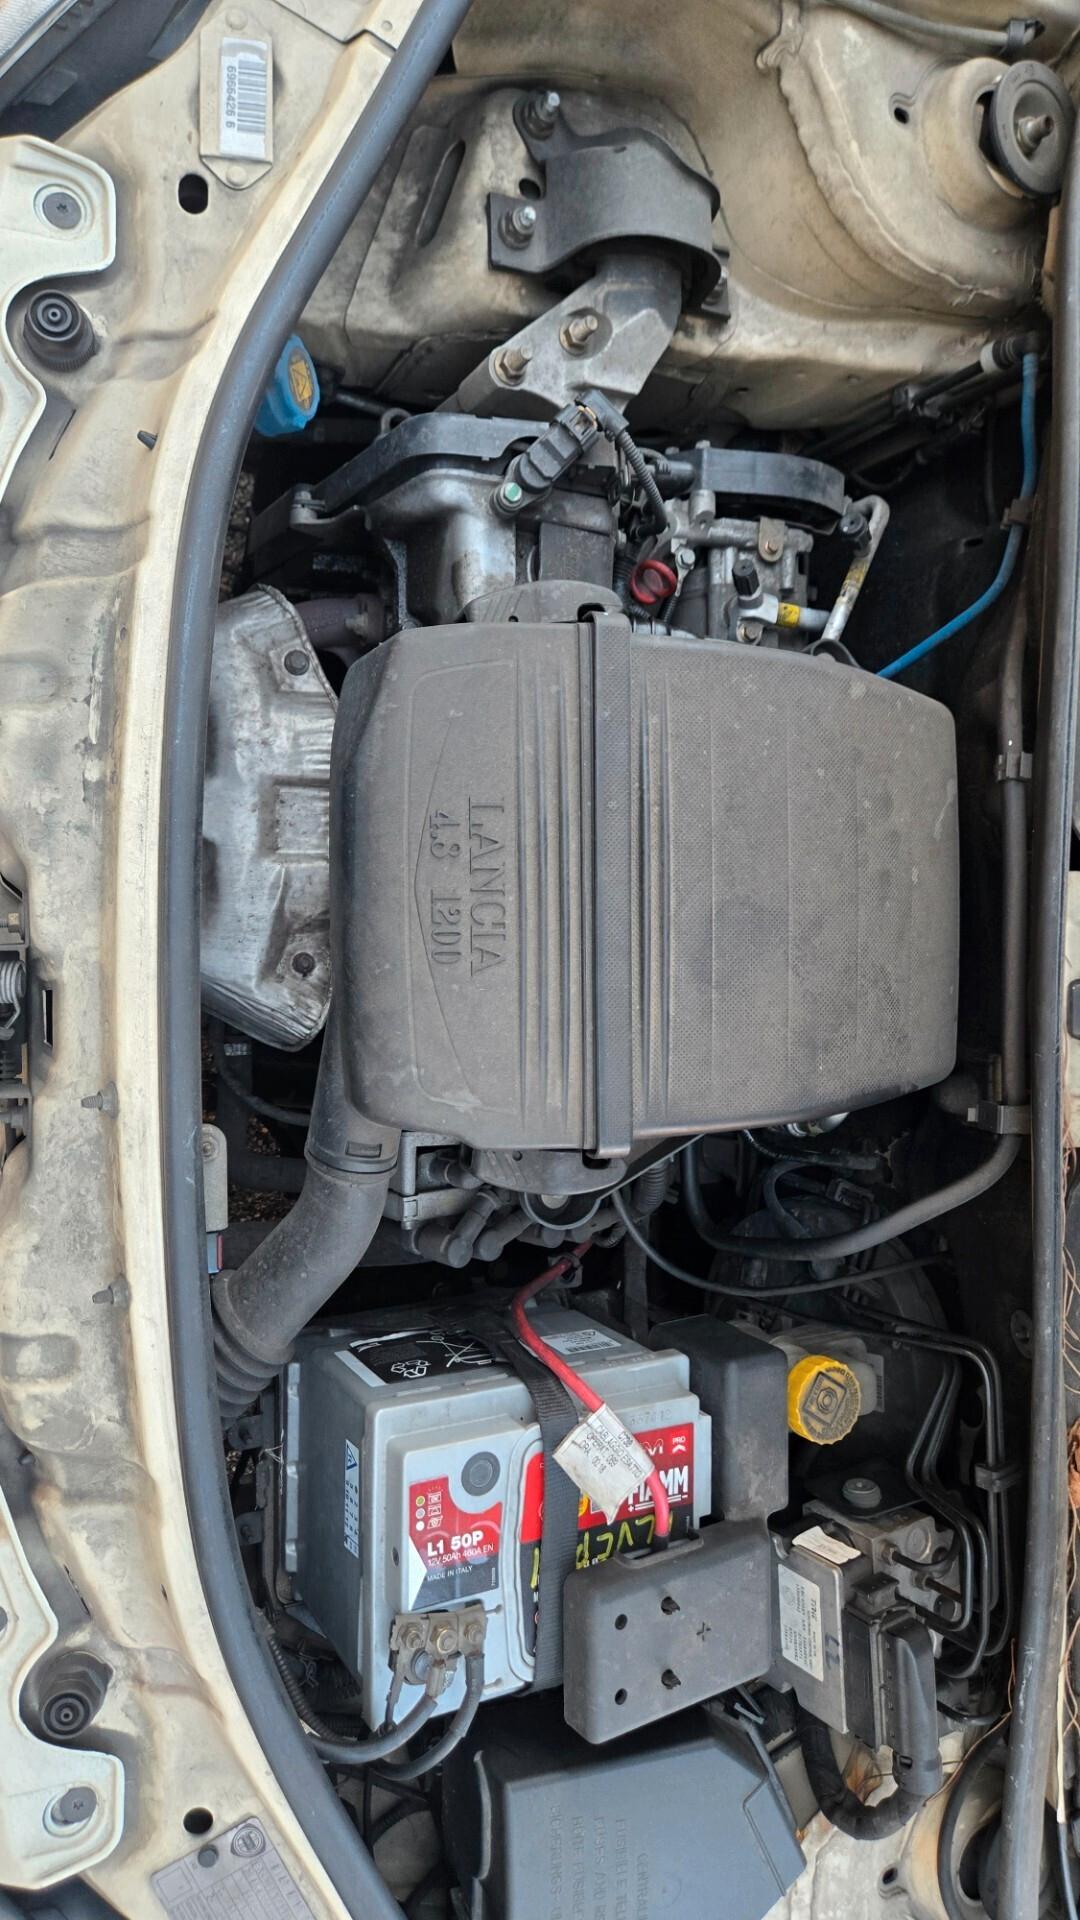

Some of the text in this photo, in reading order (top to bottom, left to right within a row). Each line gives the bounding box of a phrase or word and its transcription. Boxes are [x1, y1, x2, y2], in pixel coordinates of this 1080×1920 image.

[468, 795, 506, 977] LANCIA
[672, 1435, 686, 1444] PRO
[427, 1530, 484, 1557] L1 50P
[482, 1542, 494, 1553] EN
[447, 1568, 455, 1577] IN
[455, 1565, 473, 1576] ITALY
